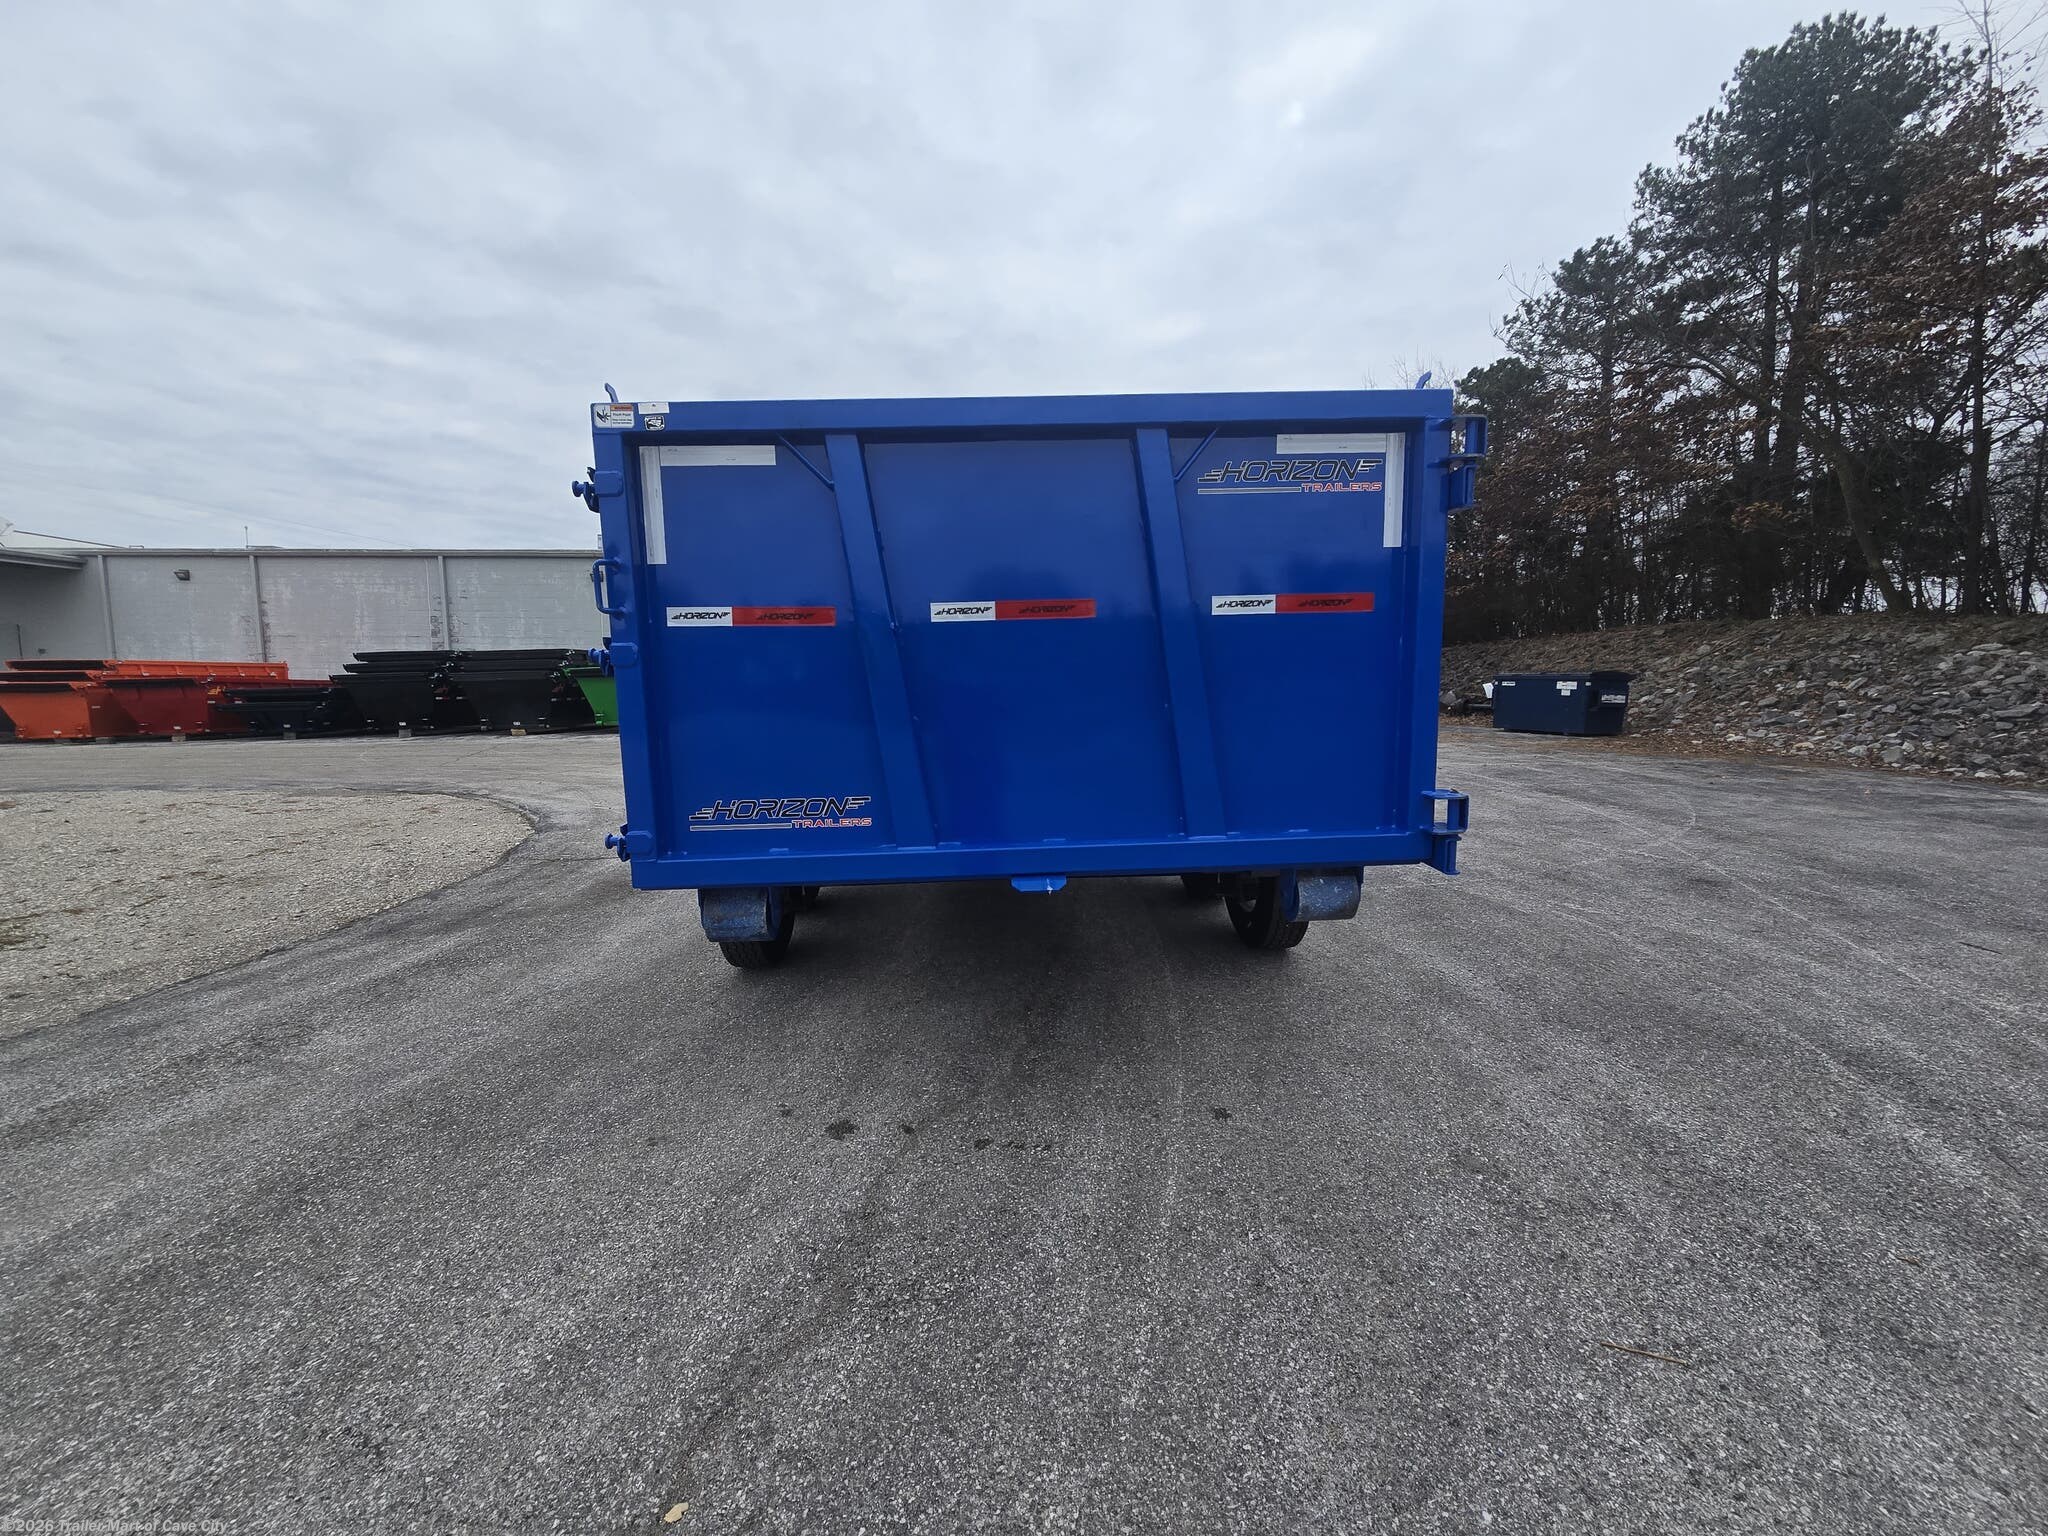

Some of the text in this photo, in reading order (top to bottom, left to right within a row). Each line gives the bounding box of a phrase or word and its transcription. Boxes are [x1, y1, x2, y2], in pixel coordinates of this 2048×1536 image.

[1218, 459, 1359, 482] HORIZON
[1301, 482, 1382, 492] TRAILERS
[1220, 599, 1268, 608] HORIZON
[939, 606, 987, 615] HORIZON
[676, 611, 726, 620] HORIZON
[762, 612, 810, 620] HORIZON
[711, 797, 849, 819] HORIZON
[792, 818, 872, 828] TRAILERS
